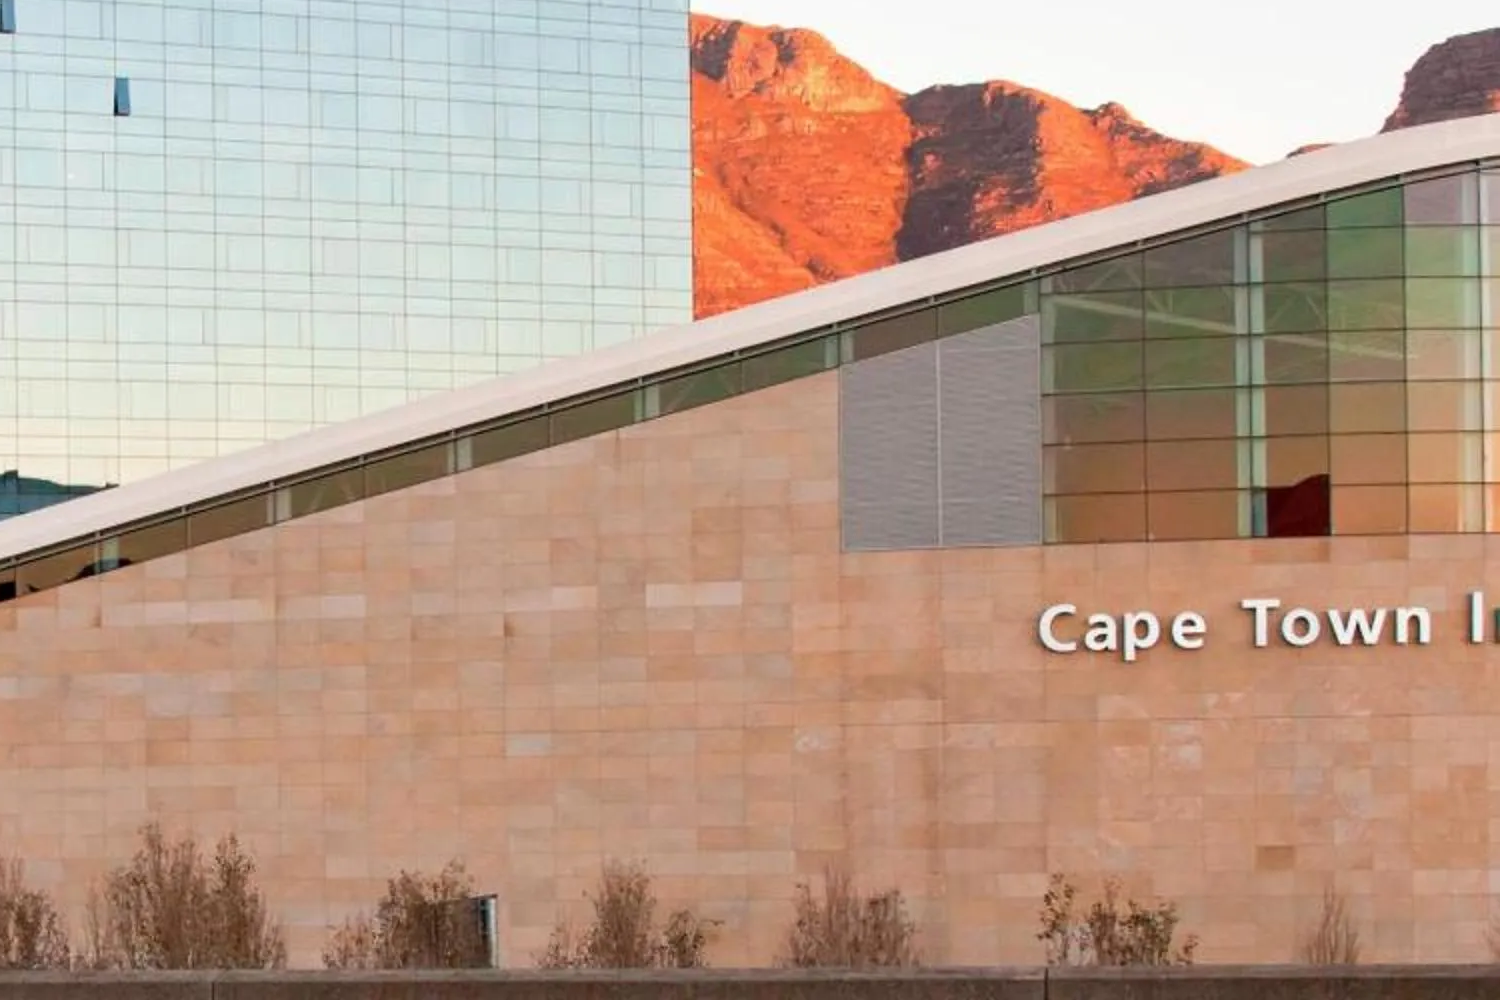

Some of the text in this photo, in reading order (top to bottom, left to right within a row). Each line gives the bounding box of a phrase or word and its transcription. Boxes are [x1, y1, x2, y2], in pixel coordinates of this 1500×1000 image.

[1038, 590, 1500, 662] Cape Town I
